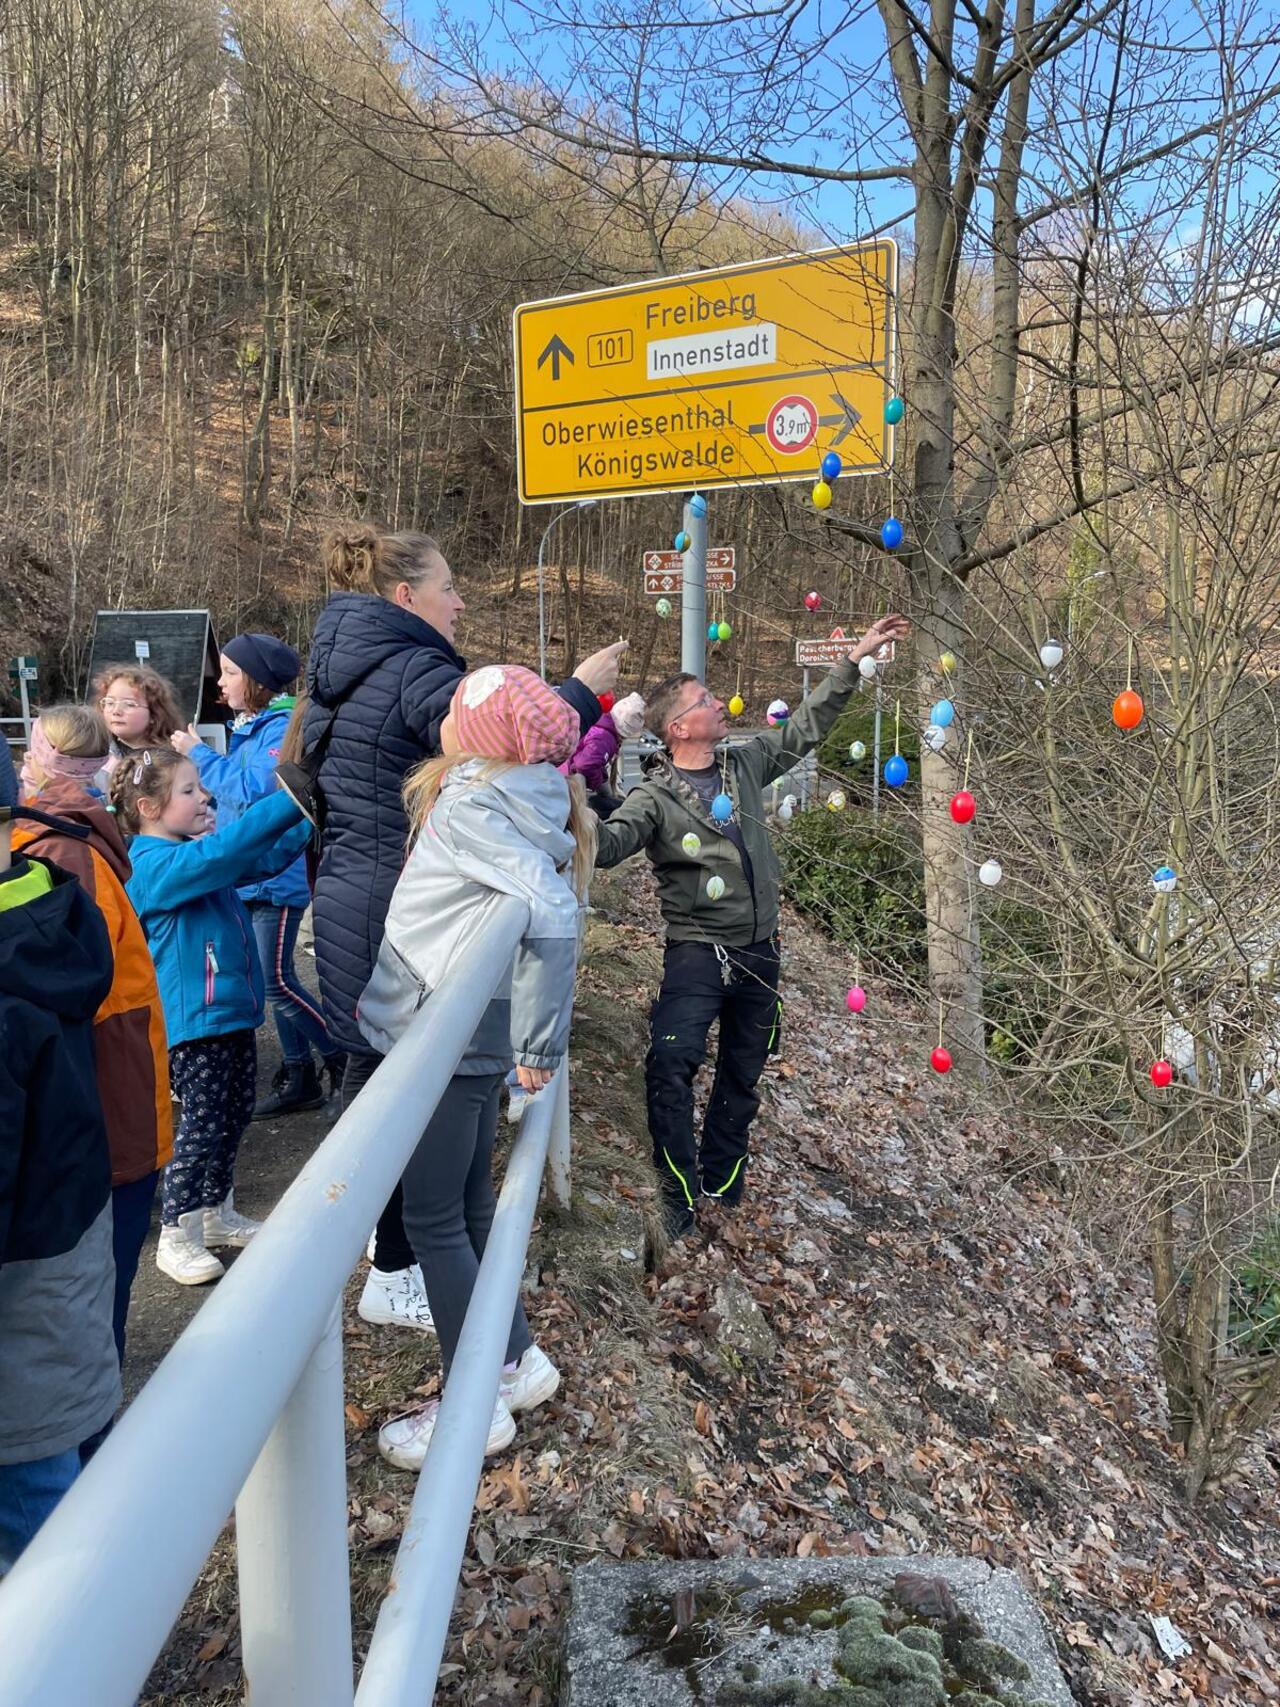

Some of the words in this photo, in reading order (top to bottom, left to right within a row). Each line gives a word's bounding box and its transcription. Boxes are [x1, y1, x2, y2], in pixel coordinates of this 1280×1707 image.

[646, 293, 756, 329] Freiberg
[597, 336, 624, 362] 101
[653, 334, 769, 371] Innenstadt
[542, 400, 734, 447] Oberwiesenthal
[577, 439, 735, 478] Königswalde
